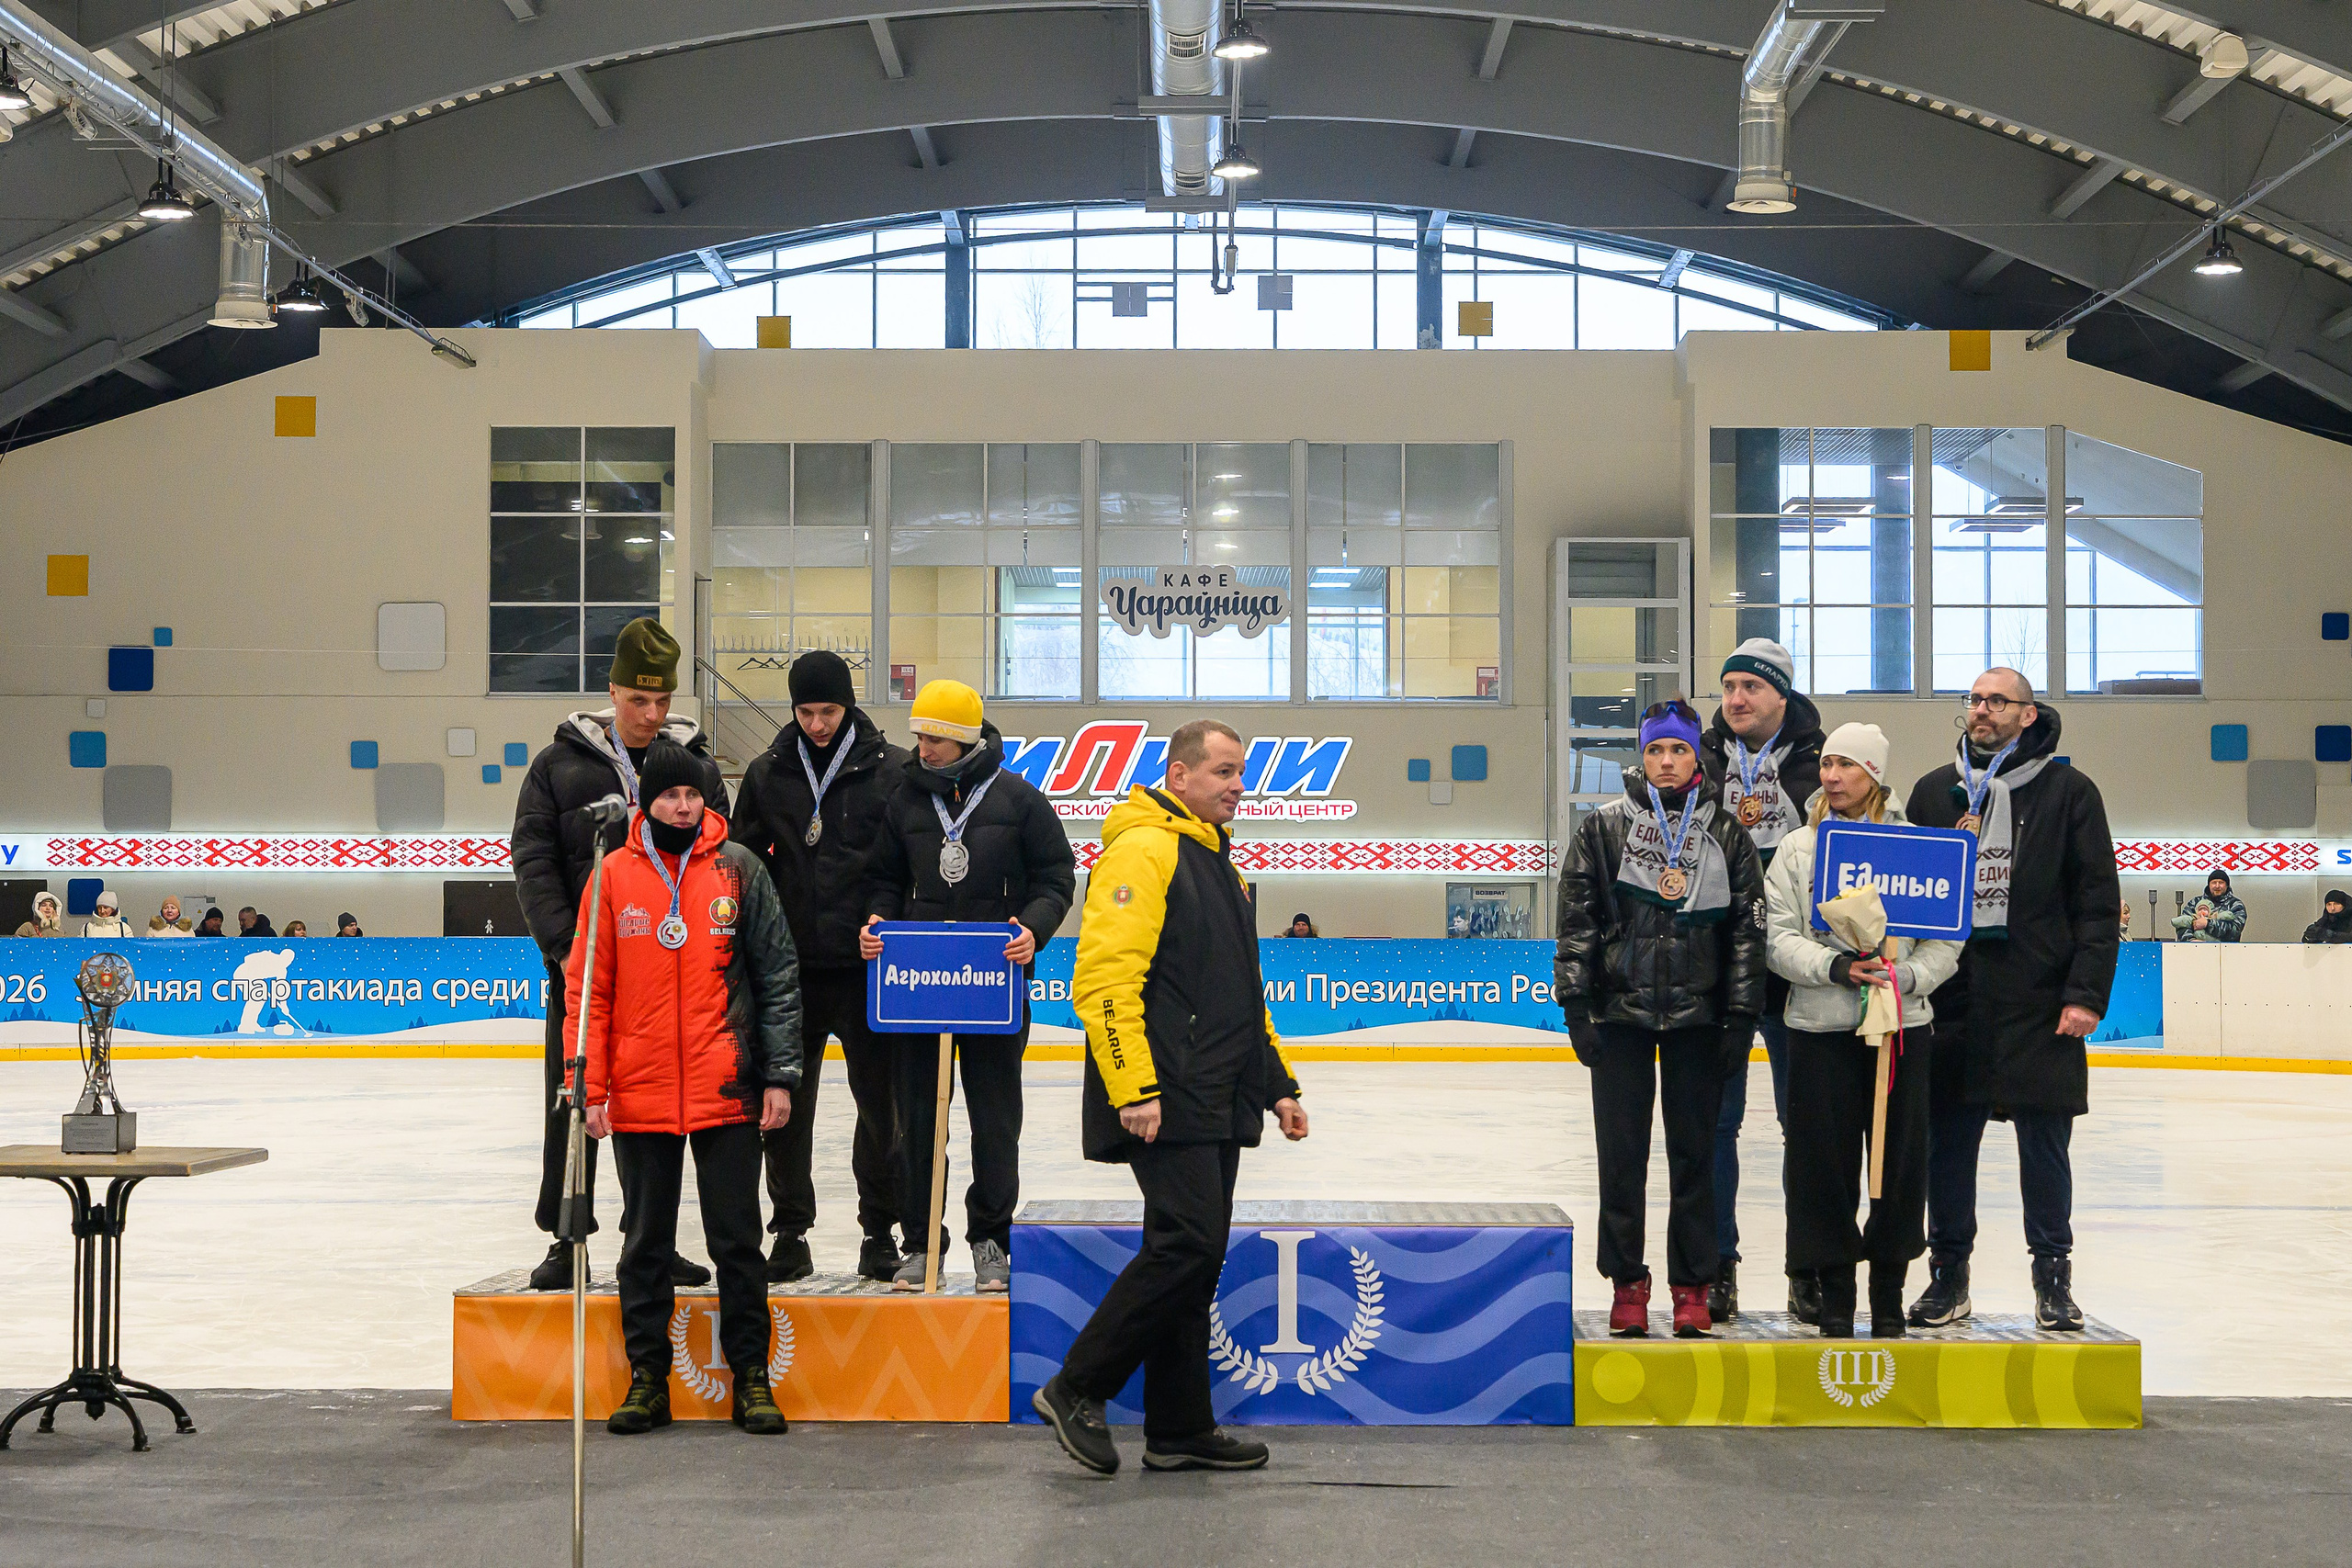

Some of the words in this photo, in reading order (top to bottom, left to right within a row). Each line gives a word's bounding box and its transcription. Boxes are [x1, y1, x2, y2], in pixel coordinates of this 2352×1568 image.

[1163, 573, 1228, 588] КАФЕ
[1109, 585, 1283, 631] Чараўніца
[1289, 804, 1353, 818] ЦЕНТР
[1838, 862, 1951, 900] Единые
[1978, 866, 2011, 884] ЕДИ
[211, 978, 424, 1009] спартакиада
[432, 978, 530, 1008] среди
[1305, 973, 1502, 1010] Президента
[884, 964, 1006, 992] Агрохолдинг
[1102, 998, 1126, 1071] BELARUS
[1260, 1231, 1316, 1353] I
[1831, 1351, 1883, 1384] III
